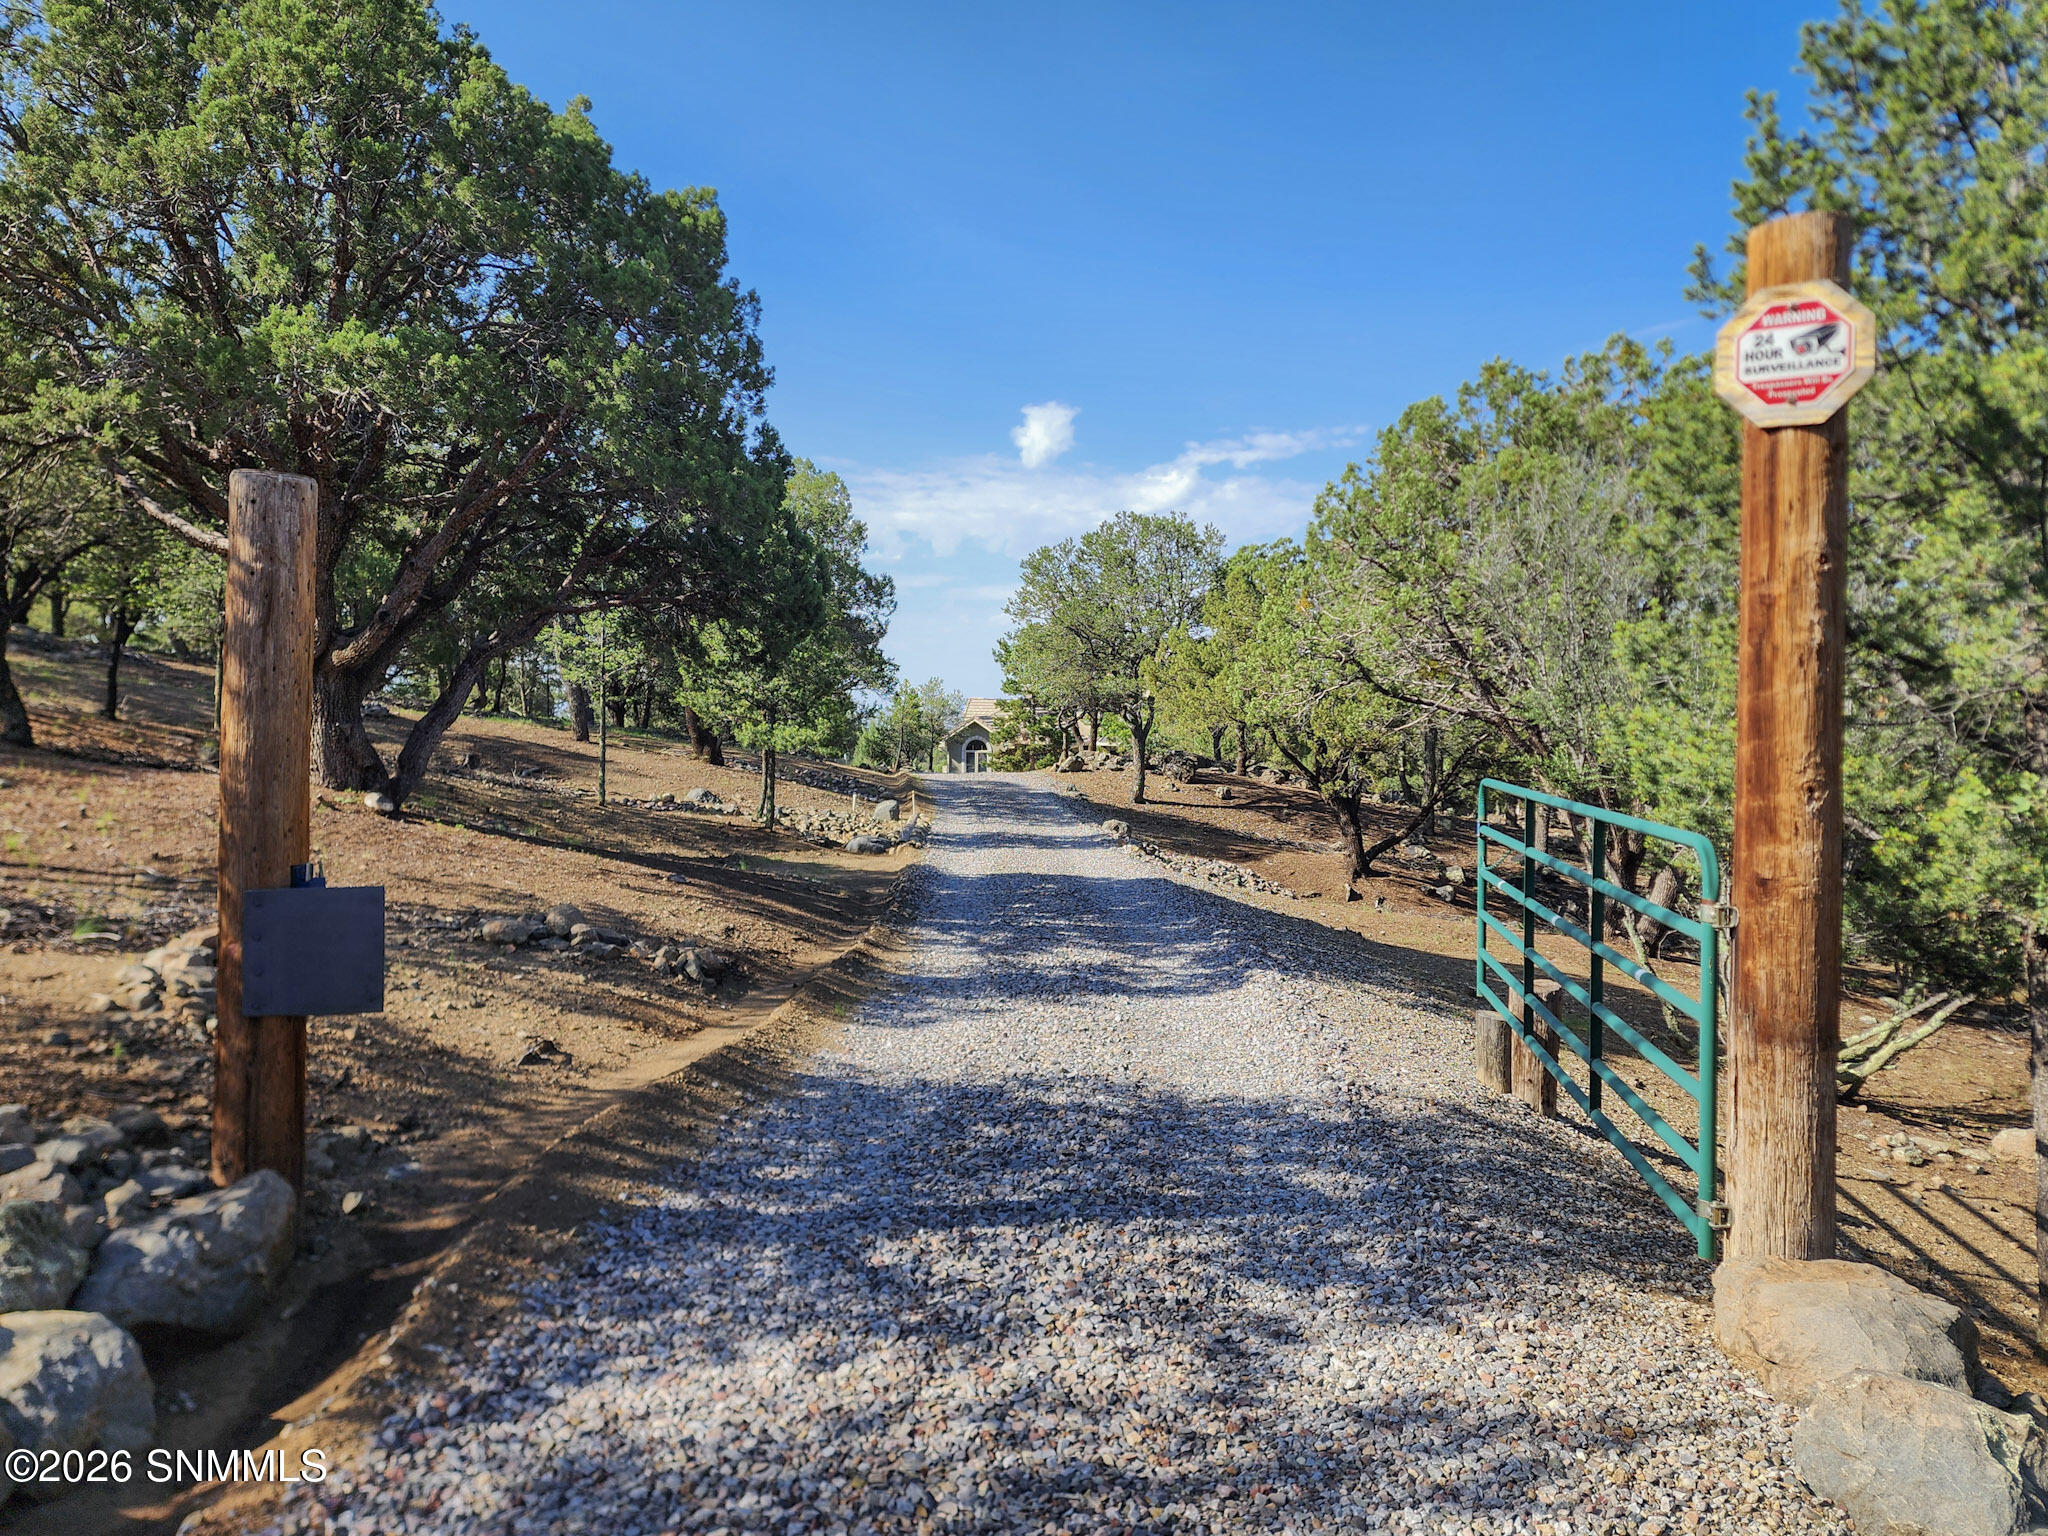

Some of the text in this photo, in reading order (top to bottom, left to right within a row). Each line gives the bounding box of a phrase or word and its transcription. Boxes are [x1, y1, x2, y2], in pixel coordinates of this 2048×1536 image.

[1763, 308, 1826, 325] WARNING
[1755, 333, 1775, 347] 24
[1745, 349, 1783, 362] HOUR
[1745, 358, 1841, 375] SURVEILLANCE
